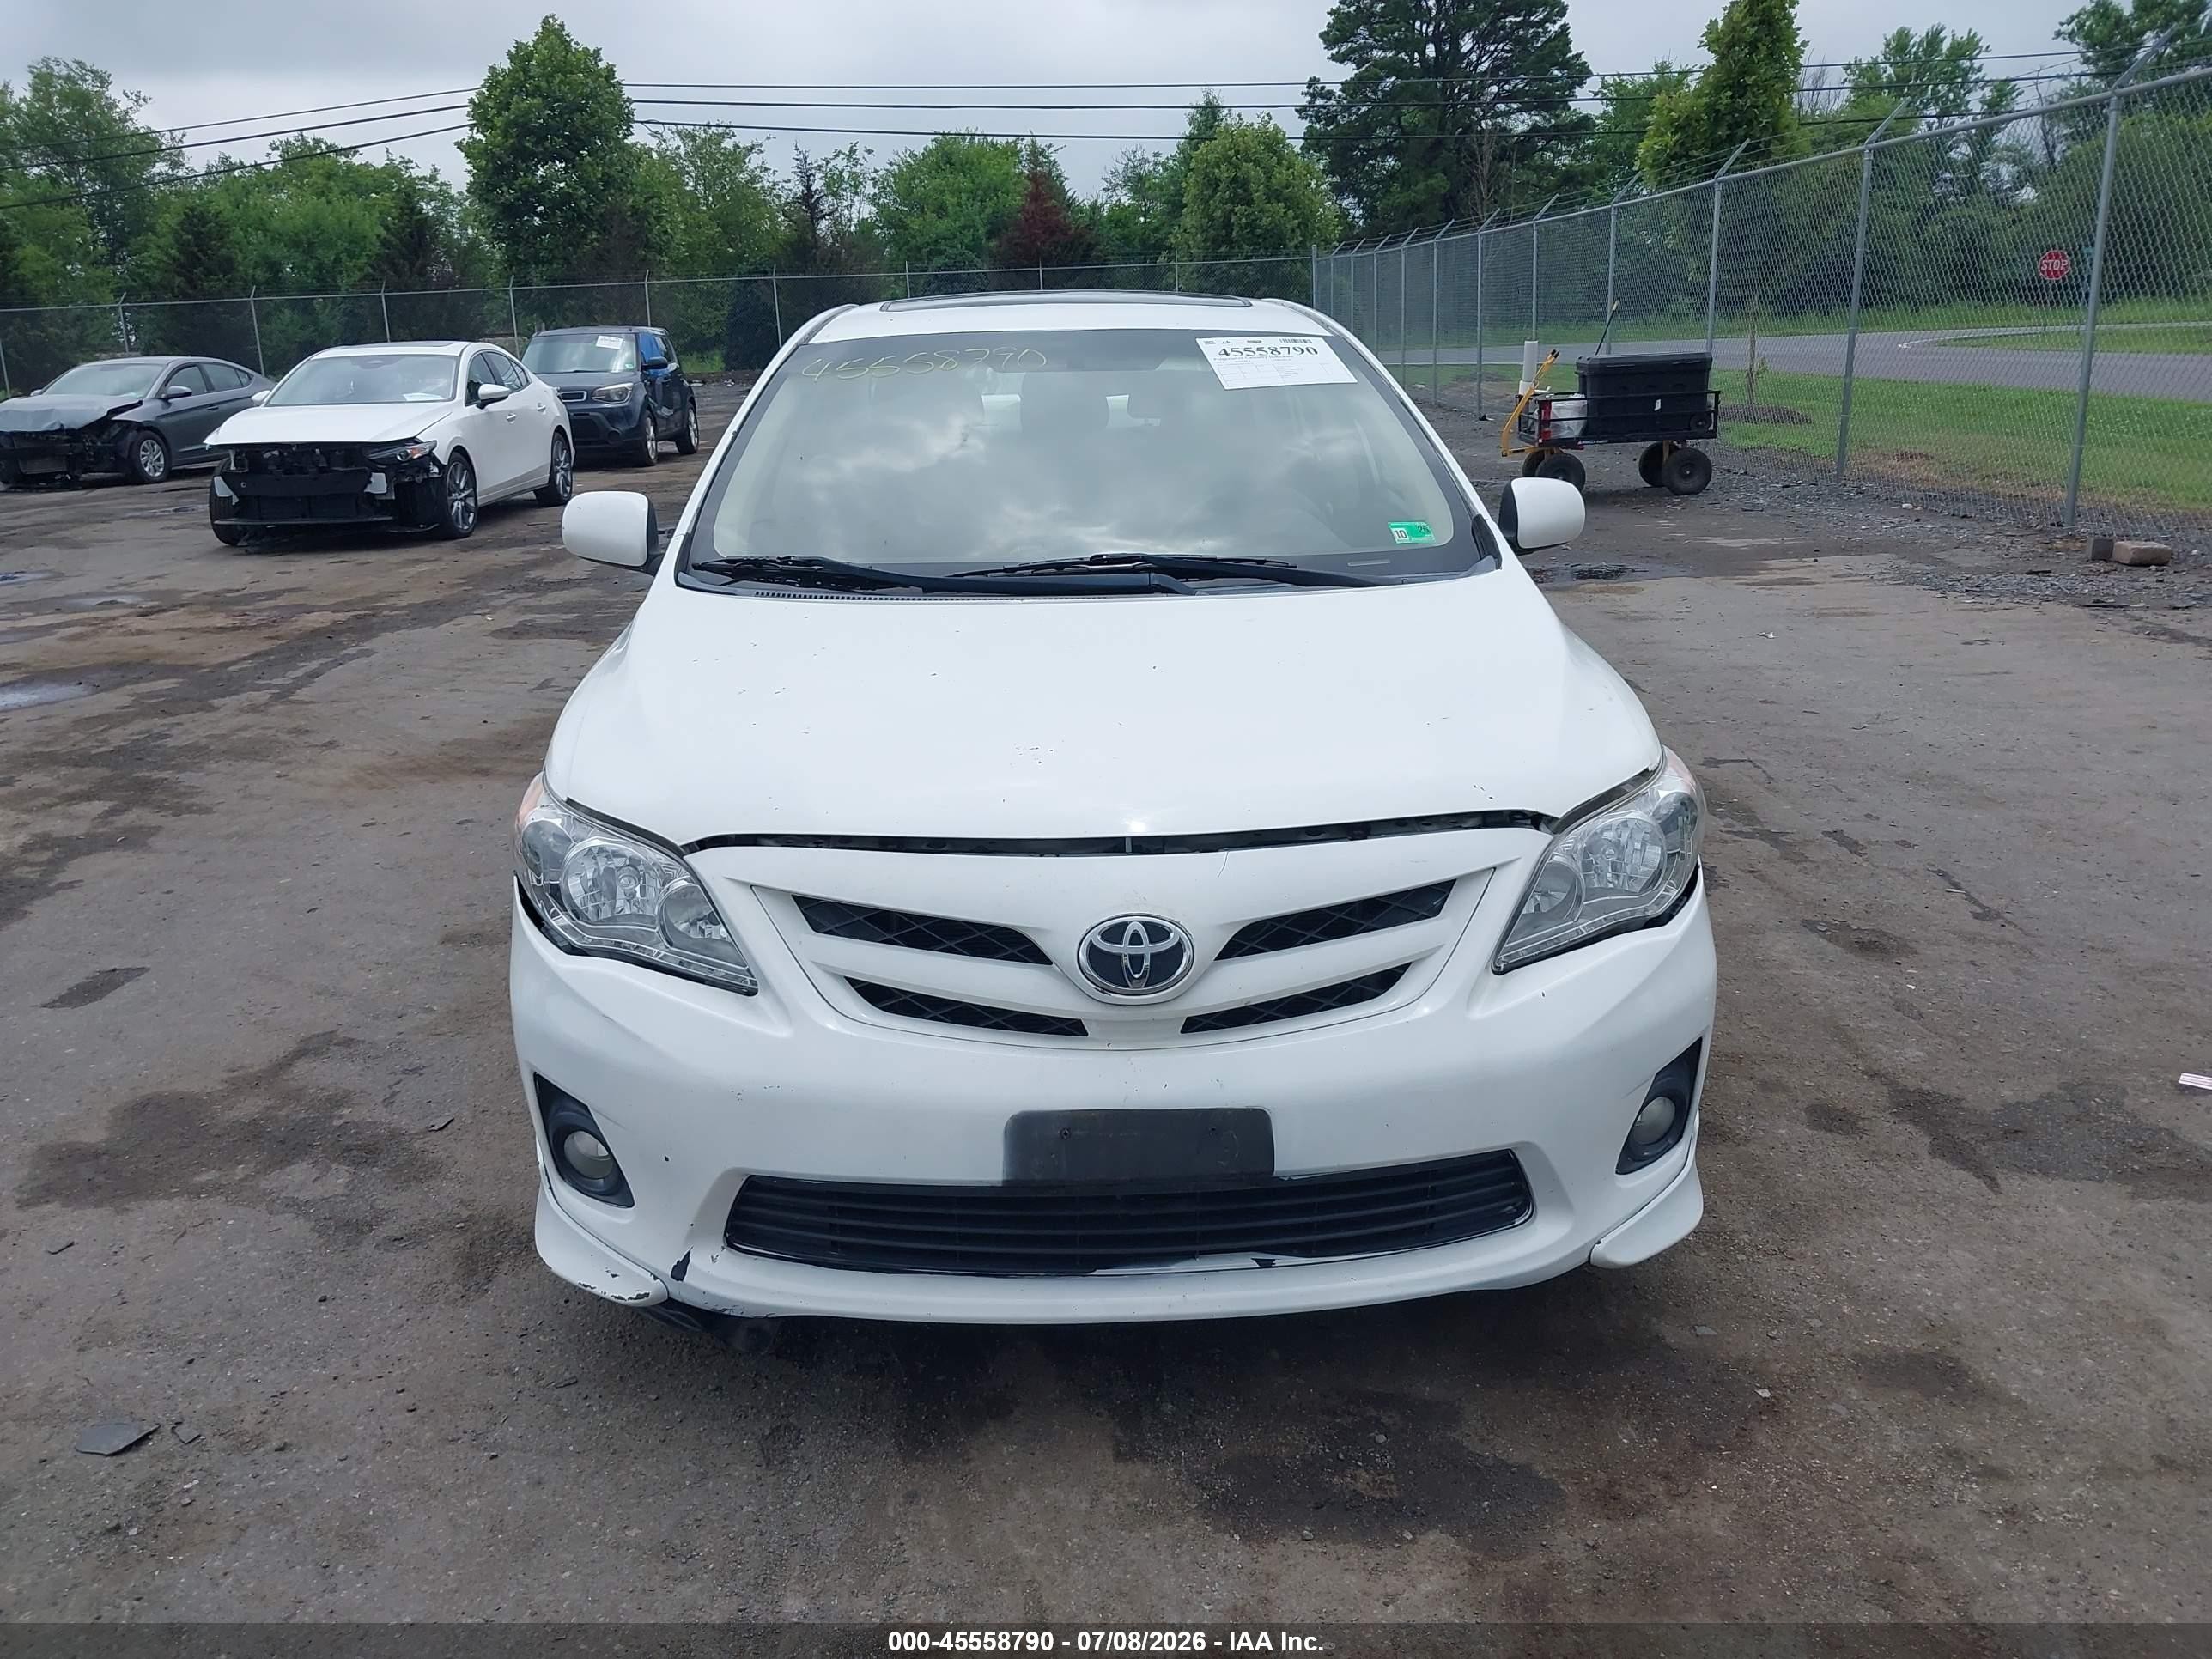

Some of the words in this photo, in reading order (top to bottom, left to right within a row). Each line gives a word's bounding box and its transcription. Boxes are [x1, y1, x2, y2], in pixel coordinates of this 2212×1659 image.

[2041, 259, 2068, 270] STOP
[1218, 346, 1318, 357] 45558790
[801, 346, 1048, 382] 45558790
[1395, 530, 1407, 539] 10
